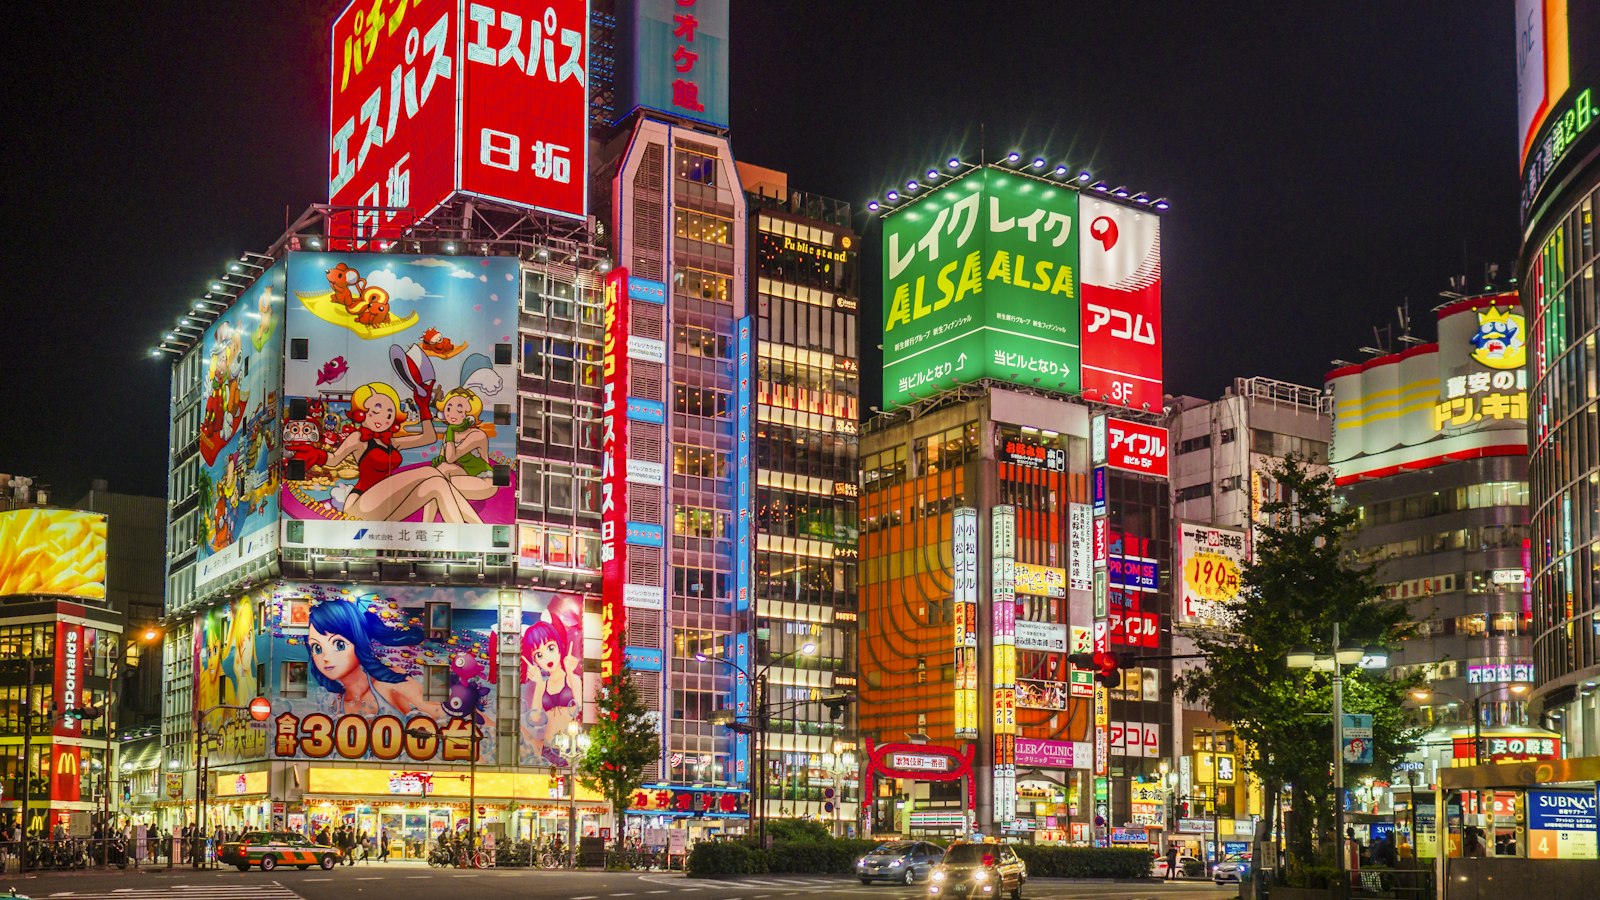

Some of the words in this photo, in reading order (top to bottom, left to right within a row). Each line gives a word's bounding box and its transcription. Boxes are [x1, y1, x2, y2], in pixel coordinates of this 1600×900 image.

[341, 0, 421, 92] パチン
[467, 3, 584, 87] エスパス
[330, 12, 451, 199] エスパス
[480, 129, 570, 184] 日拓
[889, 192, 980, 281] レイク
[989, 196, 1072, 248] レイク
[784, 237, 813, 256] Public
[816, 248, 848, 262] stand
[886, 250, 982, 332] ALSA
[987, 250, 1074, 298] ALSA
[605, 280, 617, 378] パチンコ
[1087, 303, 1156, 346] アコム
[898, 361, 952, 393] 当ビルとなり
[994, 349, 1058, 375] 当ビルとなり
[1111, 381, 1133, 400] 3F
[602, 382, 615, 514] エスパス
[1109, 427, 1166, 458] アイフル
[398, 529, 444, 542] 北電子
[955, 524, 963, 590] 小松ビル
[966, 524, 975, 590] 小松ビル
[1096, 528, 1105, 560] アイフル
[601, 602, 613, 678] パチンコ
[1110, 613, 1157, 636] アイフル
[64, 631, 78, 730] McDonald's
[1111, 726, 1158, 746] アコム
[1480, 738, 1555, 755] 安の殿堂
[671, 752, 712, 768] ダーツ
[895, 756, 945, 768] 歌舞伎町一番街
[1538, 836, 1550, 855] 4
